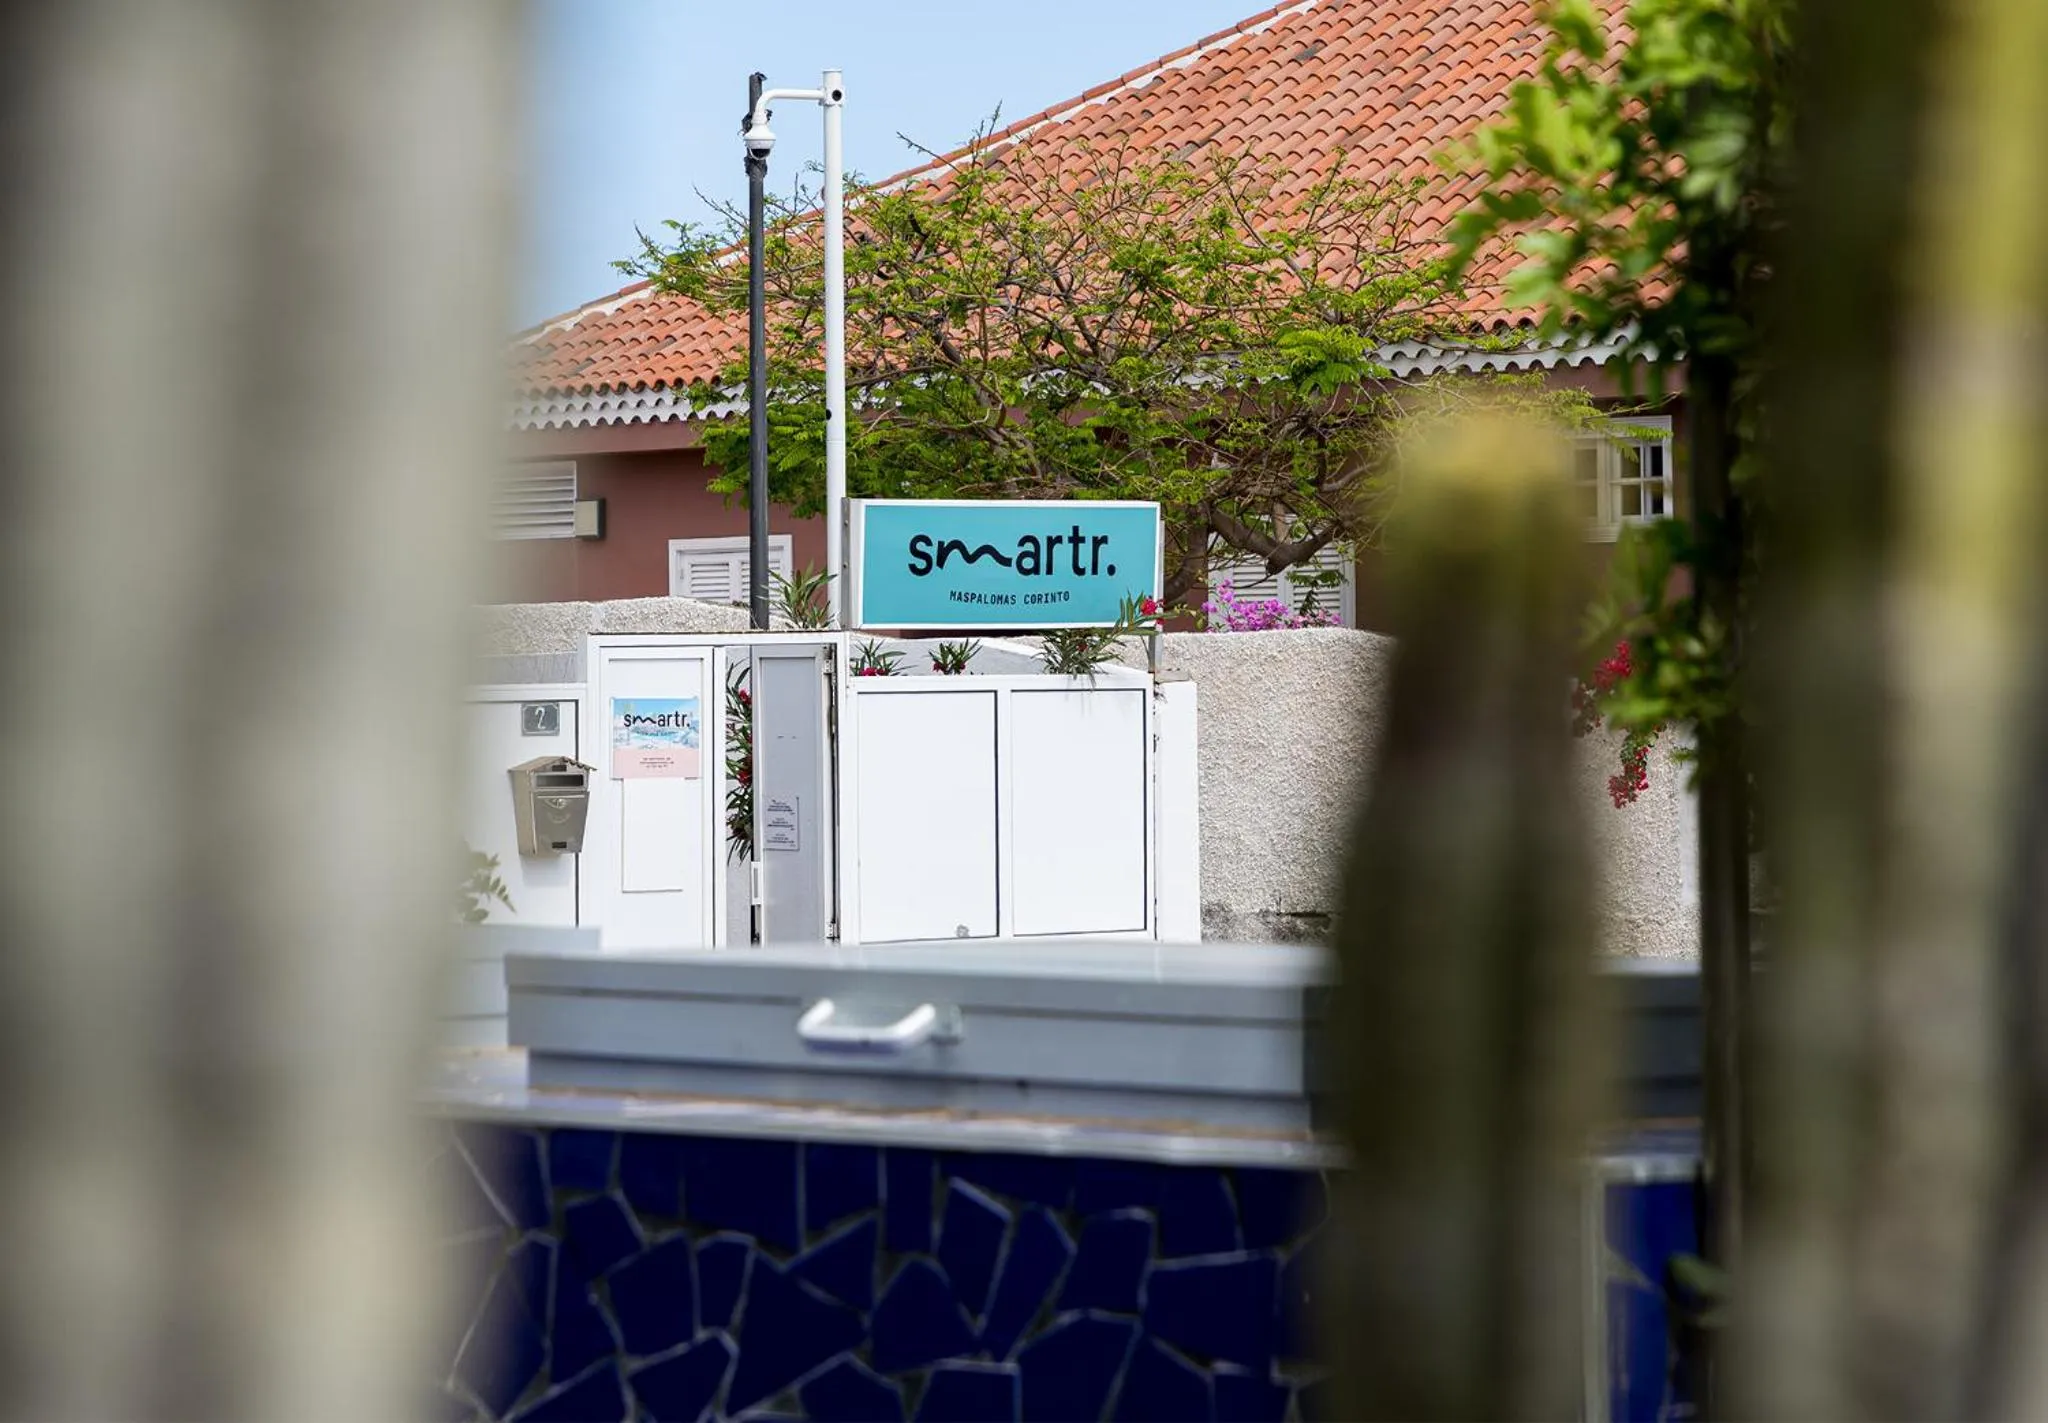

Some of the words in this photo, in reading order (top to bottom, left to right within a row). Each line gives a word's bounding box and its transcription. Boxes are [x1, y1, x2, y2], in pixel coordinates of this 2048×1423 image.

[908, 525, 1117, 577] smartr.
[949, 590, 1017, 605] MASPALOMAS
[1023, 590, 1070, 605] CORINTO
[534, 706, 546, 730] 2
[623, 710, 690, 728] smartr.
